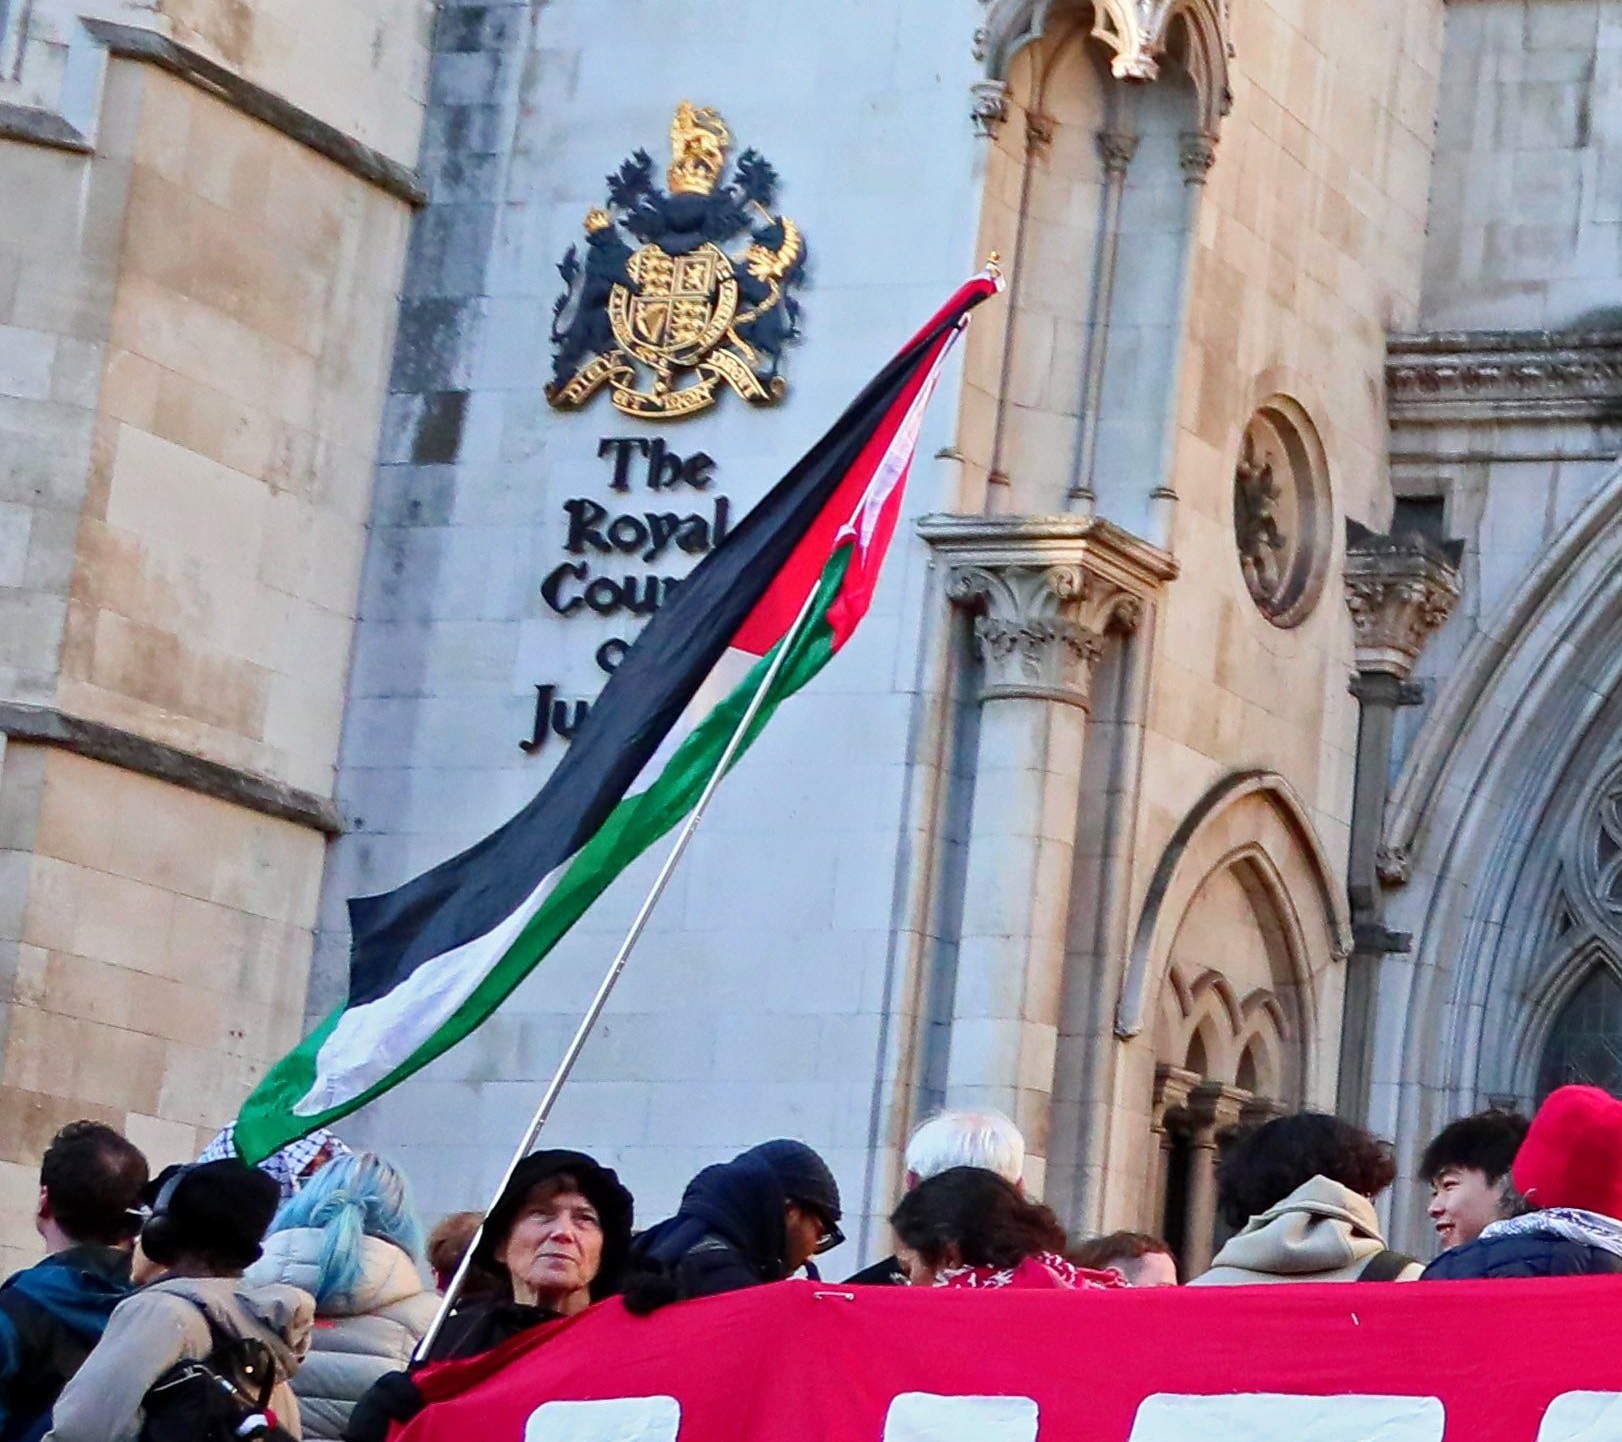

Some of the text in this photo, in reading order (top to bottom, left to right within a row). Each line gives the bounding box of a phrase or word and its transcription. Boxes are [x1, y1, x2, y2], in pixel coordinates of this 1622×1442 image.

[597, 437, 716, 492] The
[562, 494, 729, 563] Royal
[541, 561, 688, 617] Cou
